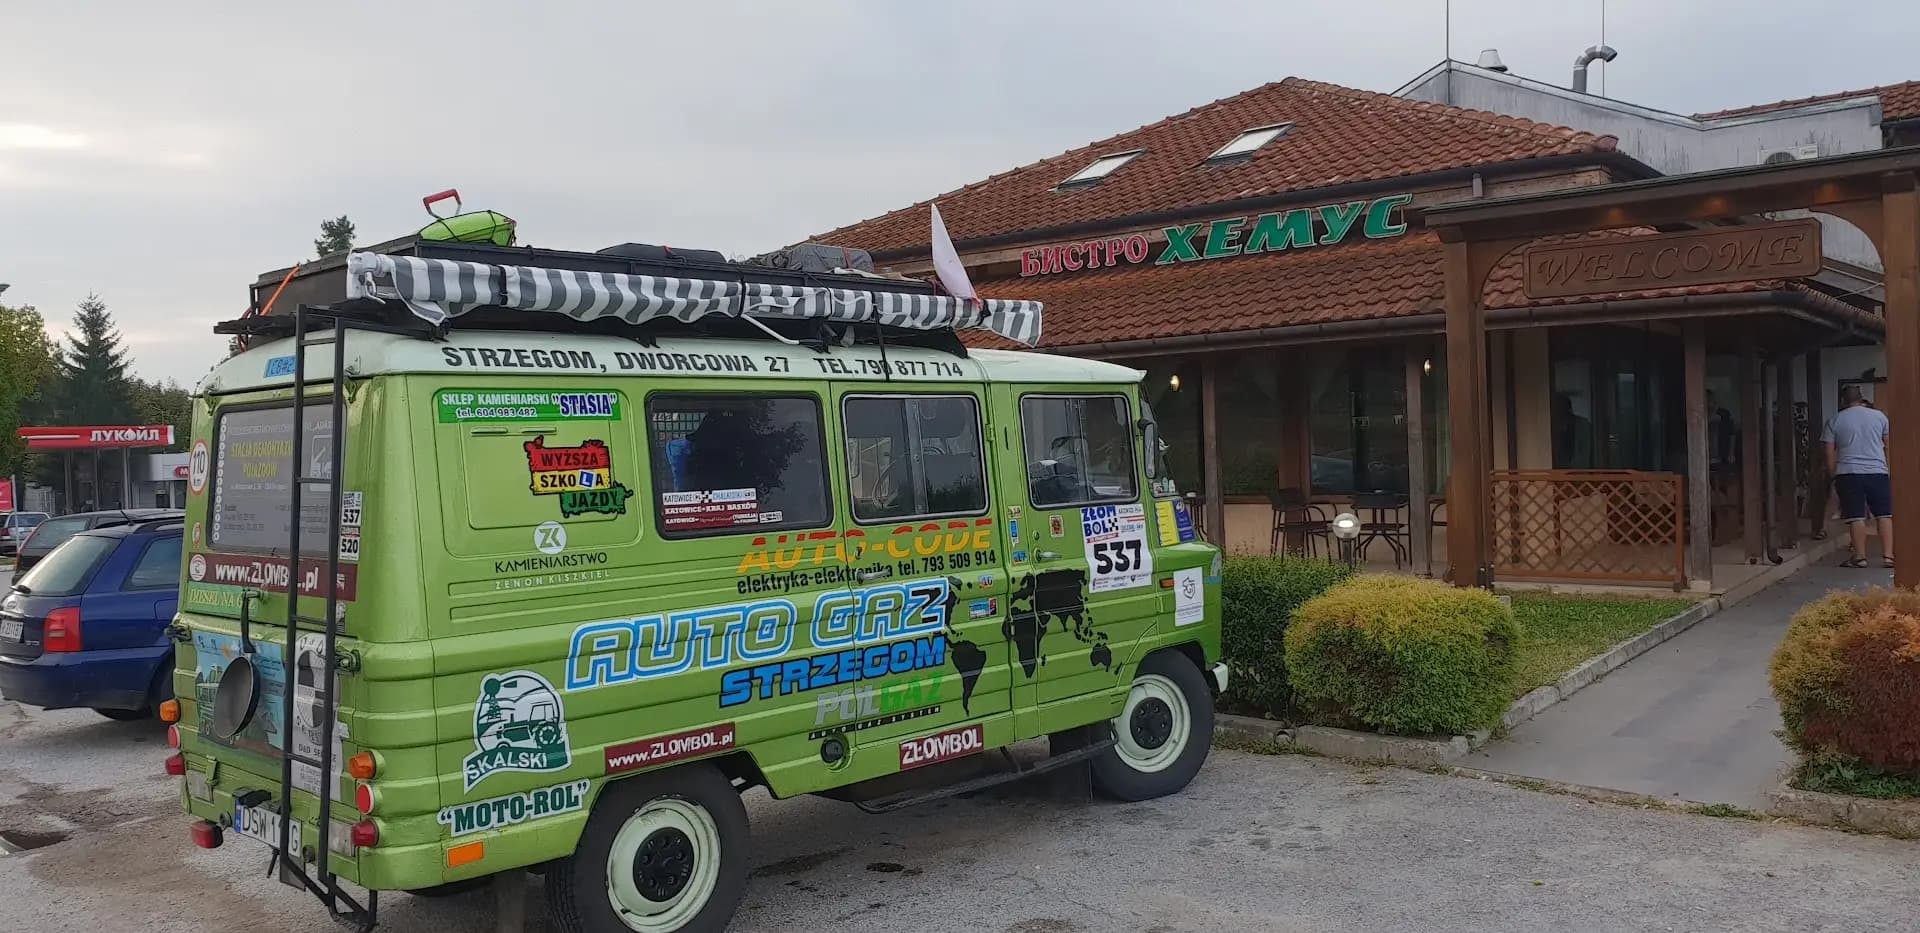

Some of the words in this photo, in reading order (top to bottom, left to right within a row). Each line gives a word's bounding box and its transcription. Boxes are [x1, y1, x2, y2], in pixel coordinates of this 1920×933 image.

[1020, 234, 1149, 277] БИСТРО
[1155, 193, 1413, 265] ХЕМУС
[1537, 233, 1808, 288] WELCOME
[441, 346, 607, 373] STRZEGOM,
[614, 351, 758, 372] DWORCOWA
[764, 356, 790, 373] 27
[895, 360, 930, 376] 877
[931, 361, 963, 377] 714
[442, 394, 474, 405] SKLEP
[478, 393, 549, 405] KAMIENIARSKI
[456, 408, 474, 418] tel.
[476, 408, 497, 417] 604
[498, 408, 515, 417] 983
[518, 407, 536, 417] 482
[90, 427, 160, 442] ЛУКОЙЛ
[193, 450, 206, 475] 110
[541, 450, 598, 467] WYŻSZA
[569, 490, 618, 508] JAZDY
[343, 509, 360, 524] 537
[1081, 505, 1116, 522] ZŁOM
[341, 539, 358, 554] 520
[736, 518, 992, 574] AUTO-CODE
[1093, 539, 1141, 575] 537
[495, 552, 608, 573] KAMIENIARSTWO
[898, 558, 920, 576] tel.
[921, 555, 944, 573] 793
[949, 552, 971, 569] 509
[975, 549, 996, 566] 914
[215, 561, 319, 592] www.ZLOMB.pl
[496, 577, 543, 590] ZENON
[549, 570, 610, 584] KISZKIEL
[565, 599, 796, 692] AUTO
[810, 577, 952, 649] GAZ
[719, 635, 946, 708] STRZEGOM
[891, 706, 940, 723] SYSTEM
[902, 728, 982, 764] ZŁOMBOL
[465, 752, 548, 780] SKALSKI
[242, 806, 267, 840] DSW
